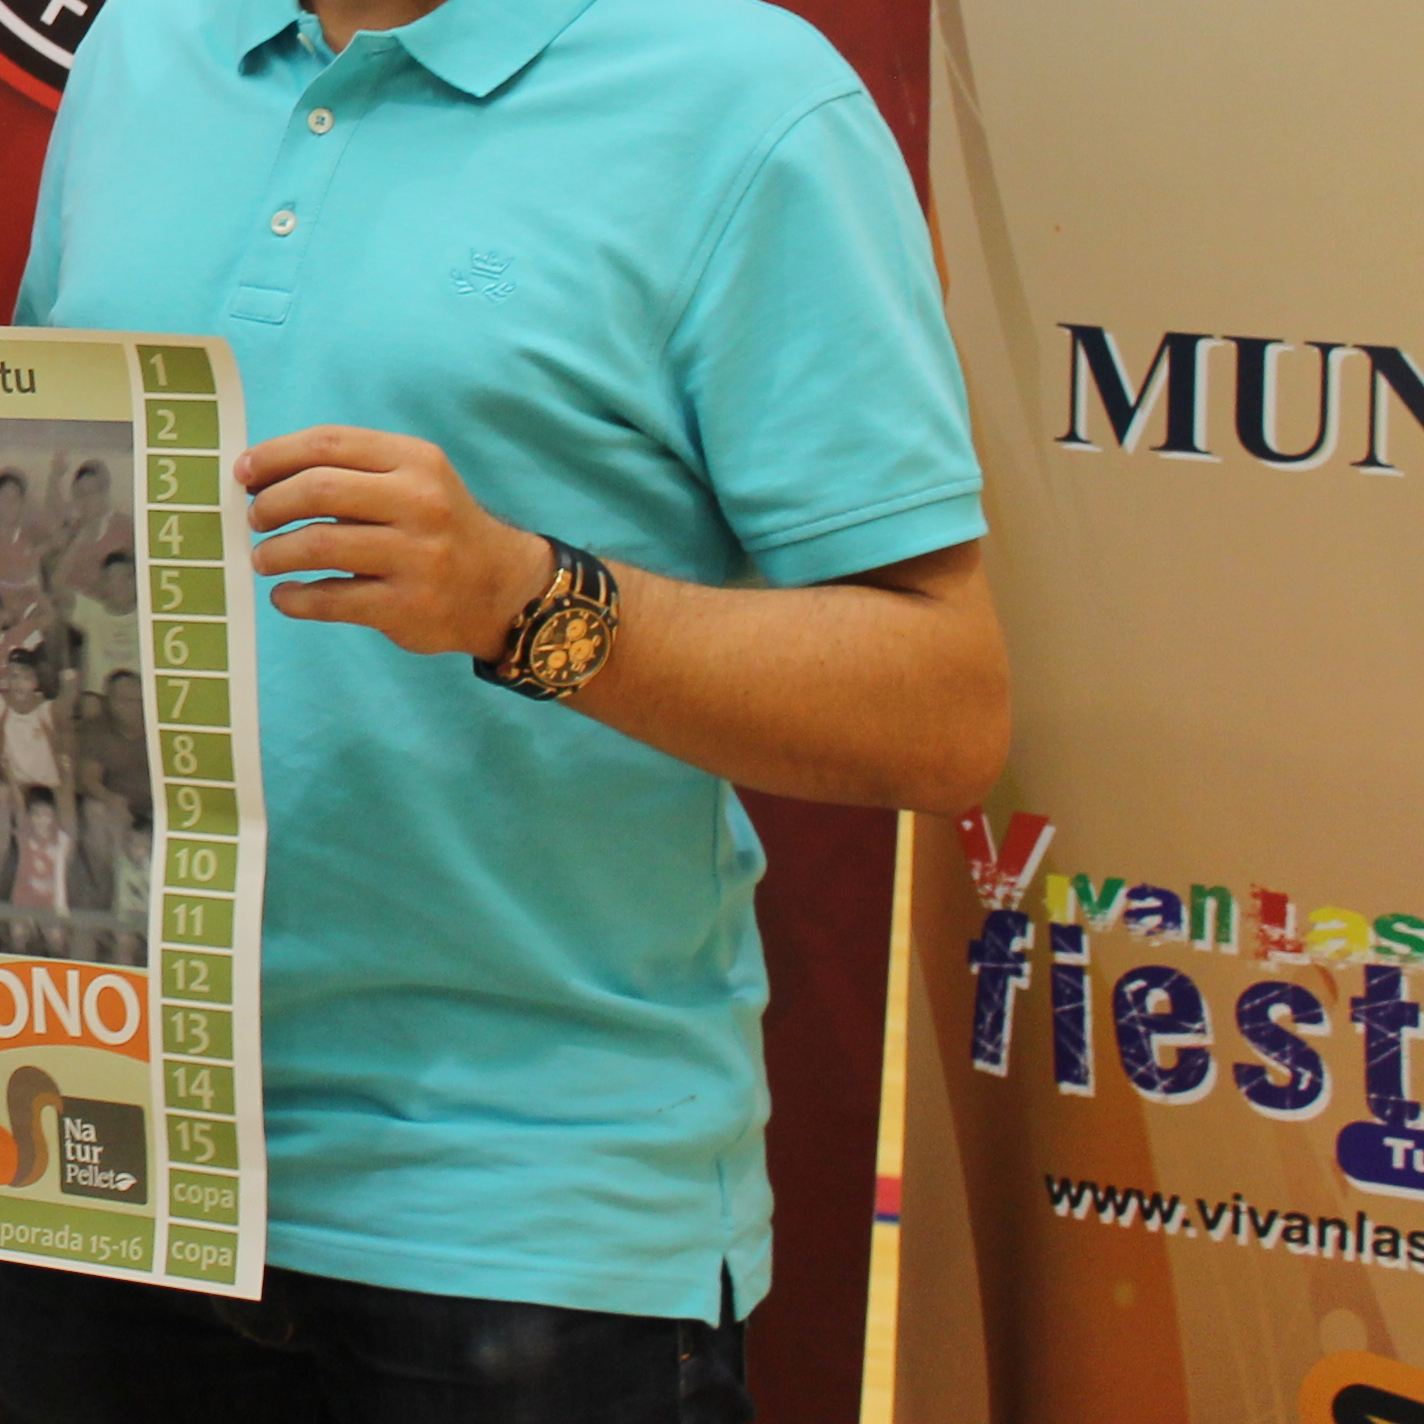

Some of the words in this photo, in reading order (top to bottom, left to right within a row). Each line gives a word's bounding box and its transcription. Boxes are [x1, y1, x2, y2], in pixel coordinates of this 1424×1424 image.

[149, 353, 168, 387] 1
[156, 408, 178, 441] 2
[156, 458, 178, 502] 3
[157, 513, 184, 555] 4
[159, 569, 184, 612] 5
[163, 625, 190, 665] 6
[167, 682, 191, 720] 7
[172, 735, 197, 774] 8
[177, 788, 202, 828] 9
[175, 848, 218, 882] 10
[955, 805, 1237, 950] Vivan
[172, 903, 205, 936] 11
[170, 958, 211, 994] 12
[170, 1012, 210, 1054] 13
[173, 1068, 214, 1110] 14
[63, 1117, 98, 1144] Na
[175, 1121, 215, 1164] 15
[63, 1141, 104, 1165] tur
[64, 1162, 119, 1189] Pellet
[172, 1179, 236, 1211] copa
[89, 1234, 144, 1261] 15-16
[170, 1237, 234, 1270] copa
